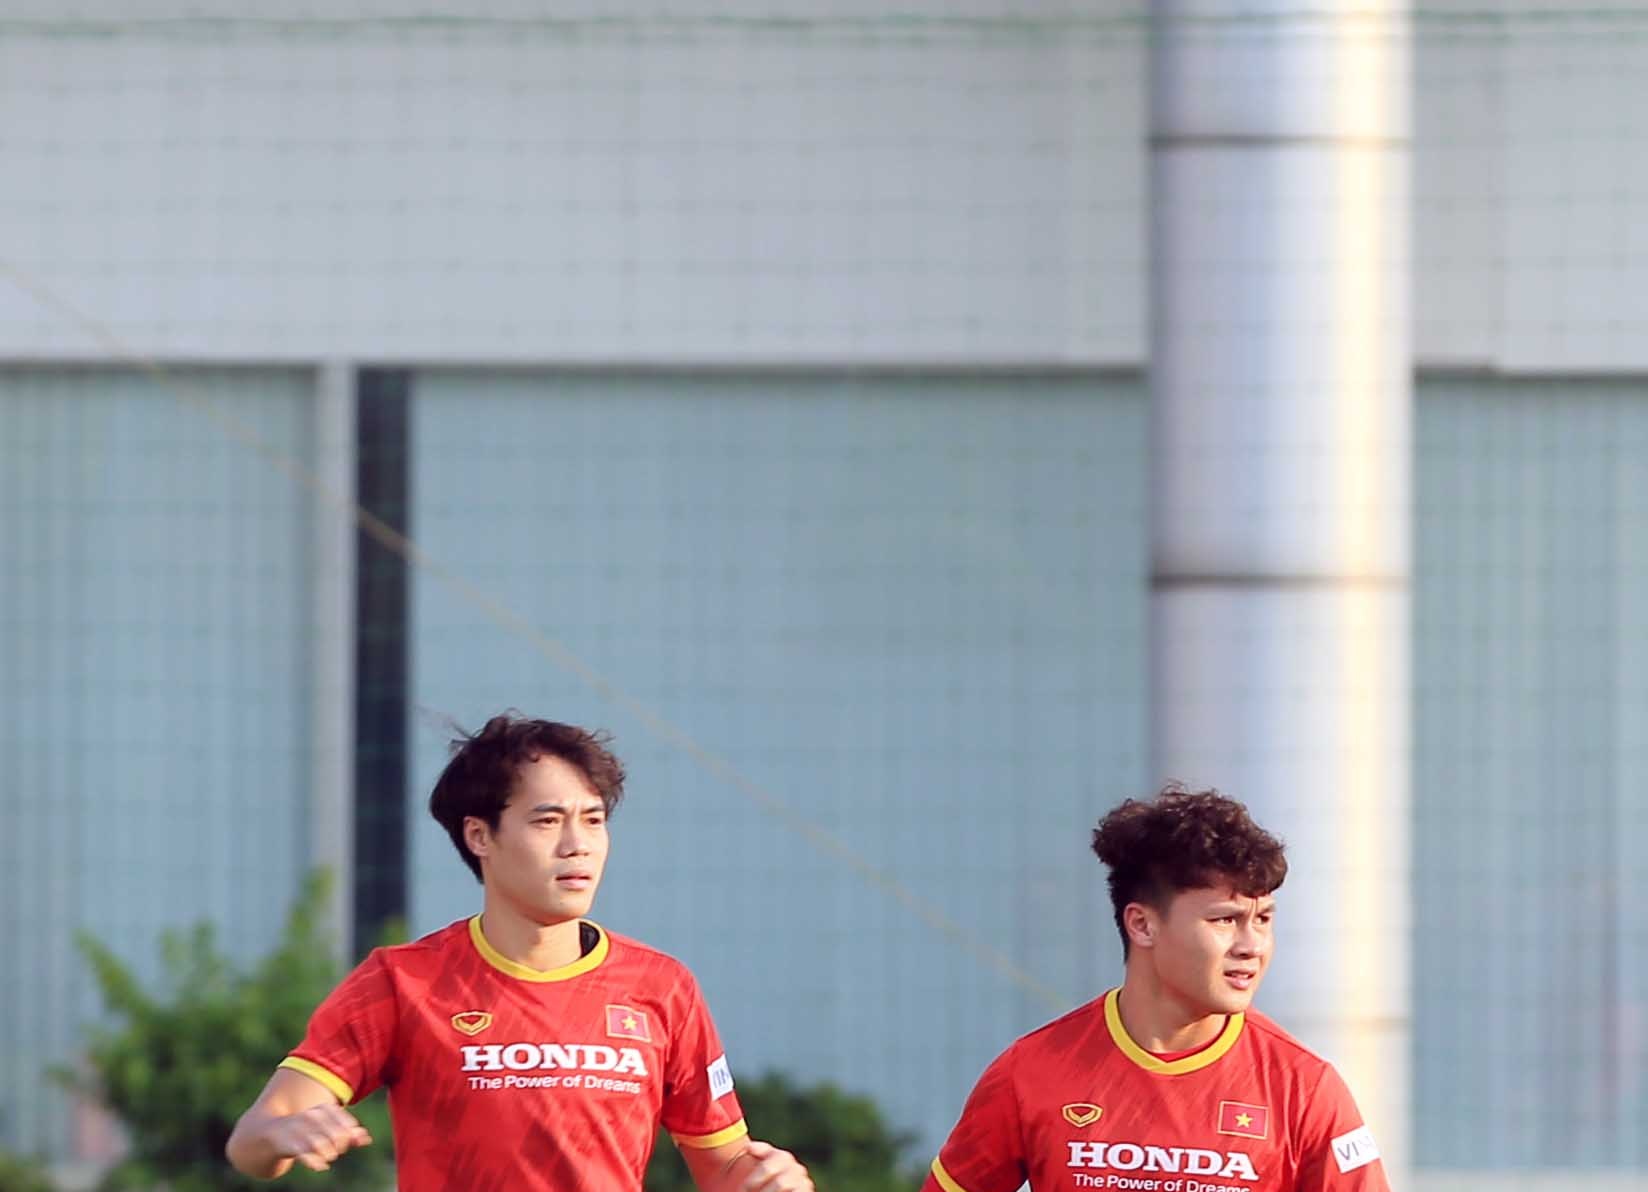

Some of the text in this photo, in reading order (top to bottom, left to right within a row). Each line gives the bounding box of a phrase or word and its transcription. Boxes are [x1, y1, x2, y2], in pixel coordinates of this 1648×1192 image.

[460, 1042, 650, 1077] HONDA
[468, 1074, 641, 1095] The Power of Dreams
[1067, 1141, 1259, 1181] HONDA
[1073, 1173, 1105, 1188] The
[1106, 1175, 1162, 1190] Power
[1164, 1179, 1183, 1192] of
